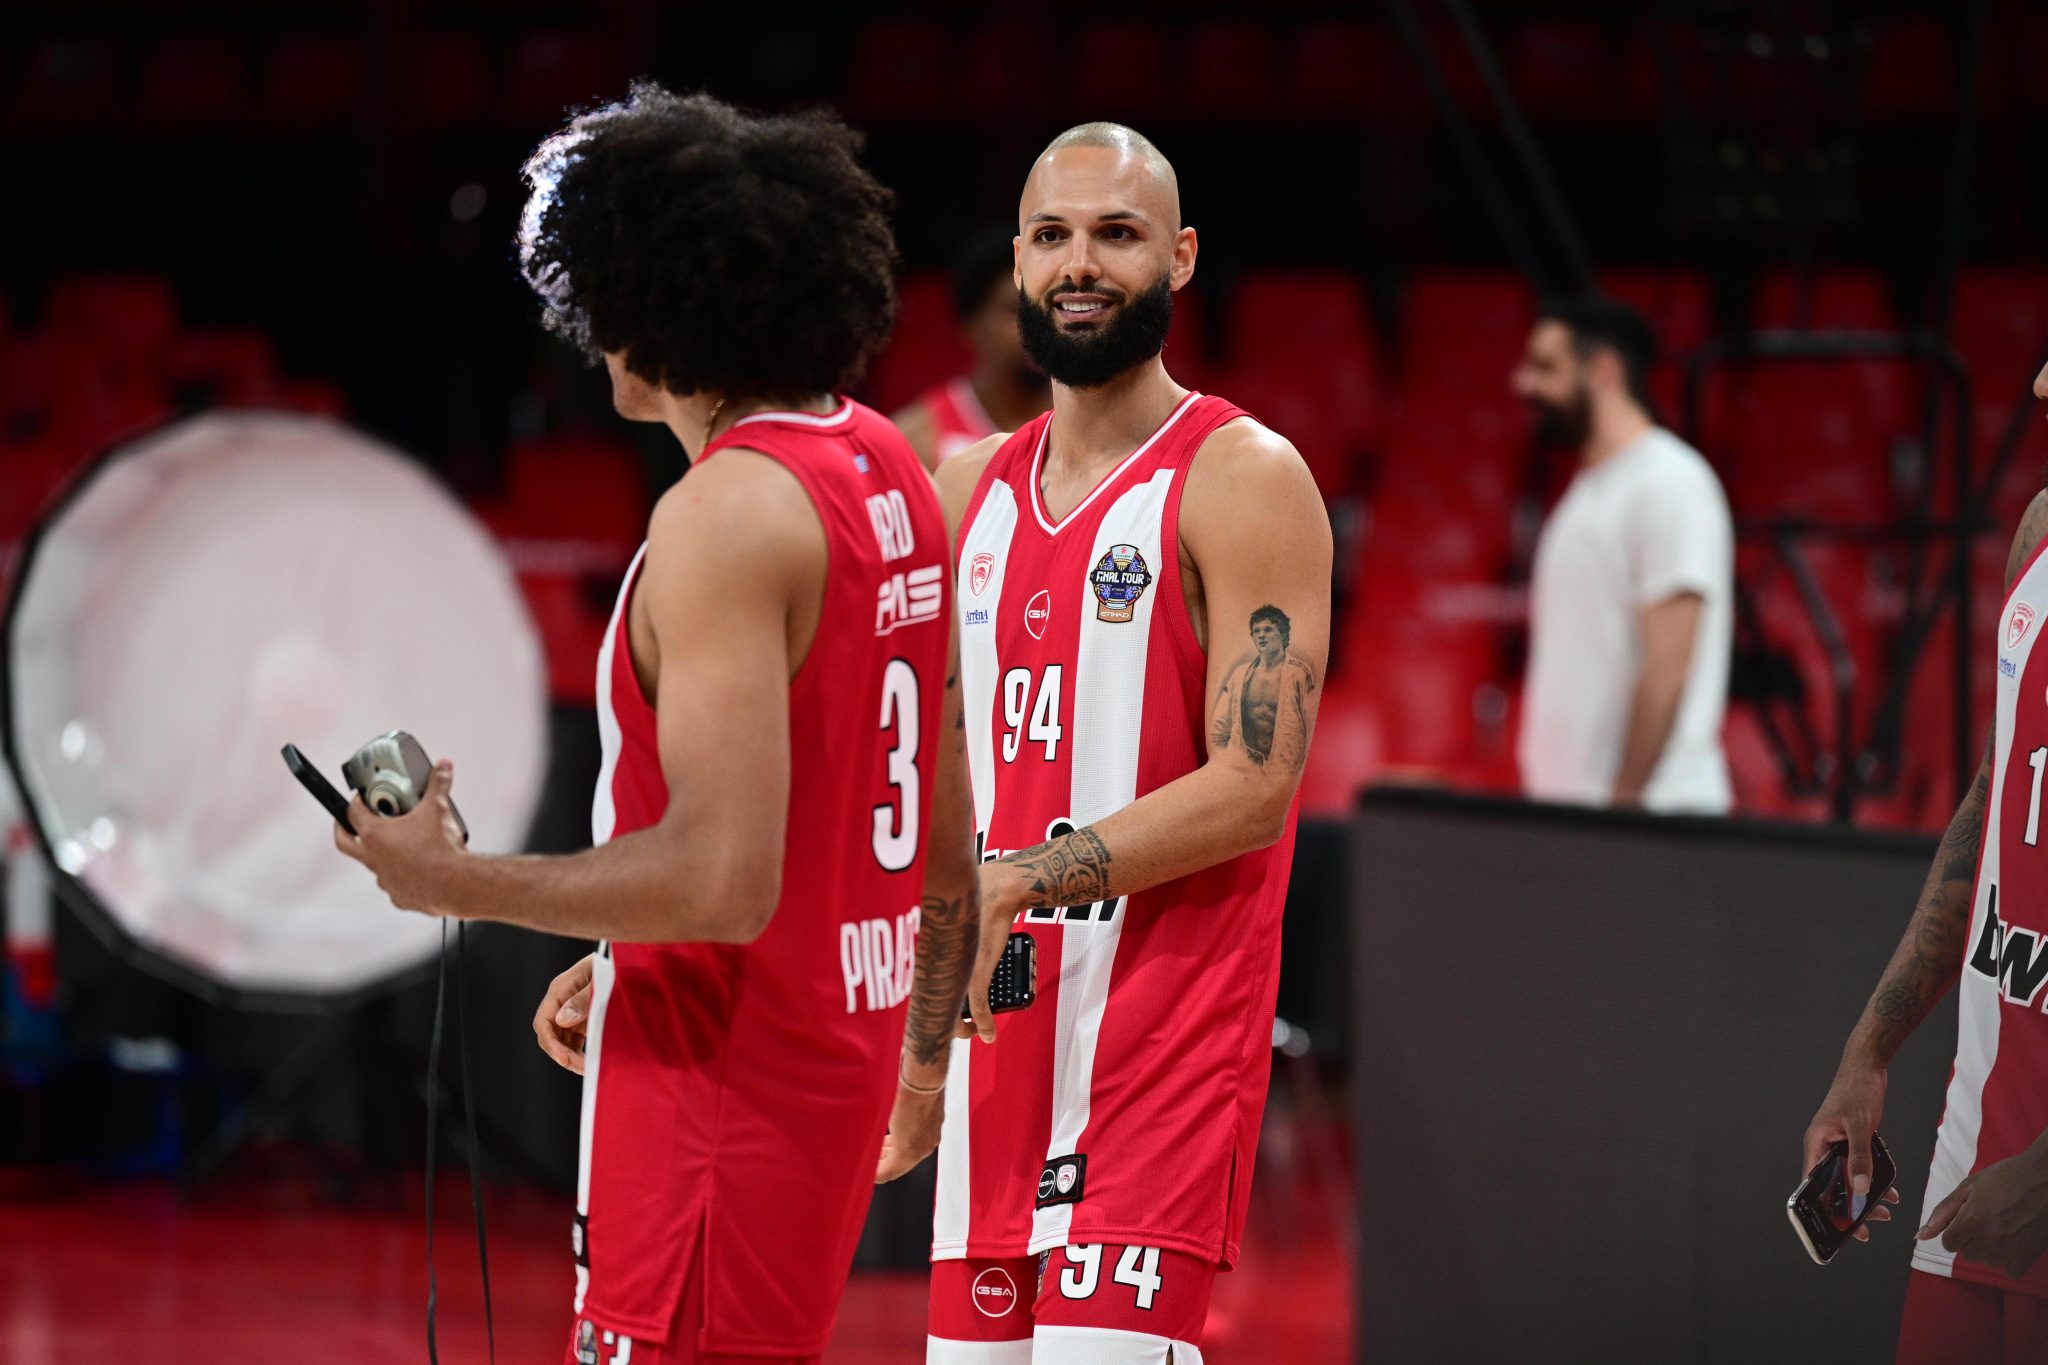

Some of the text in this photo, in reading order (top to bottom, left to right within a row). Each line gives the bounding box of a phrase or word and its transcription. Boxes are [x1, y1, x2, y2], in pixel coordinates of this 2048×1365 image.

[1121, 572, 1144, 584] FOUR
[1028, 608, 1047, 619] GS
[1002, 664, 1063, 763] 94
[872, 657, 919, 873] 3
[1968, 883, 2048, 1005] bw
[976, 1286, 1013, 1297] GSA
[1059, 1243, 1164, 1310] 94
